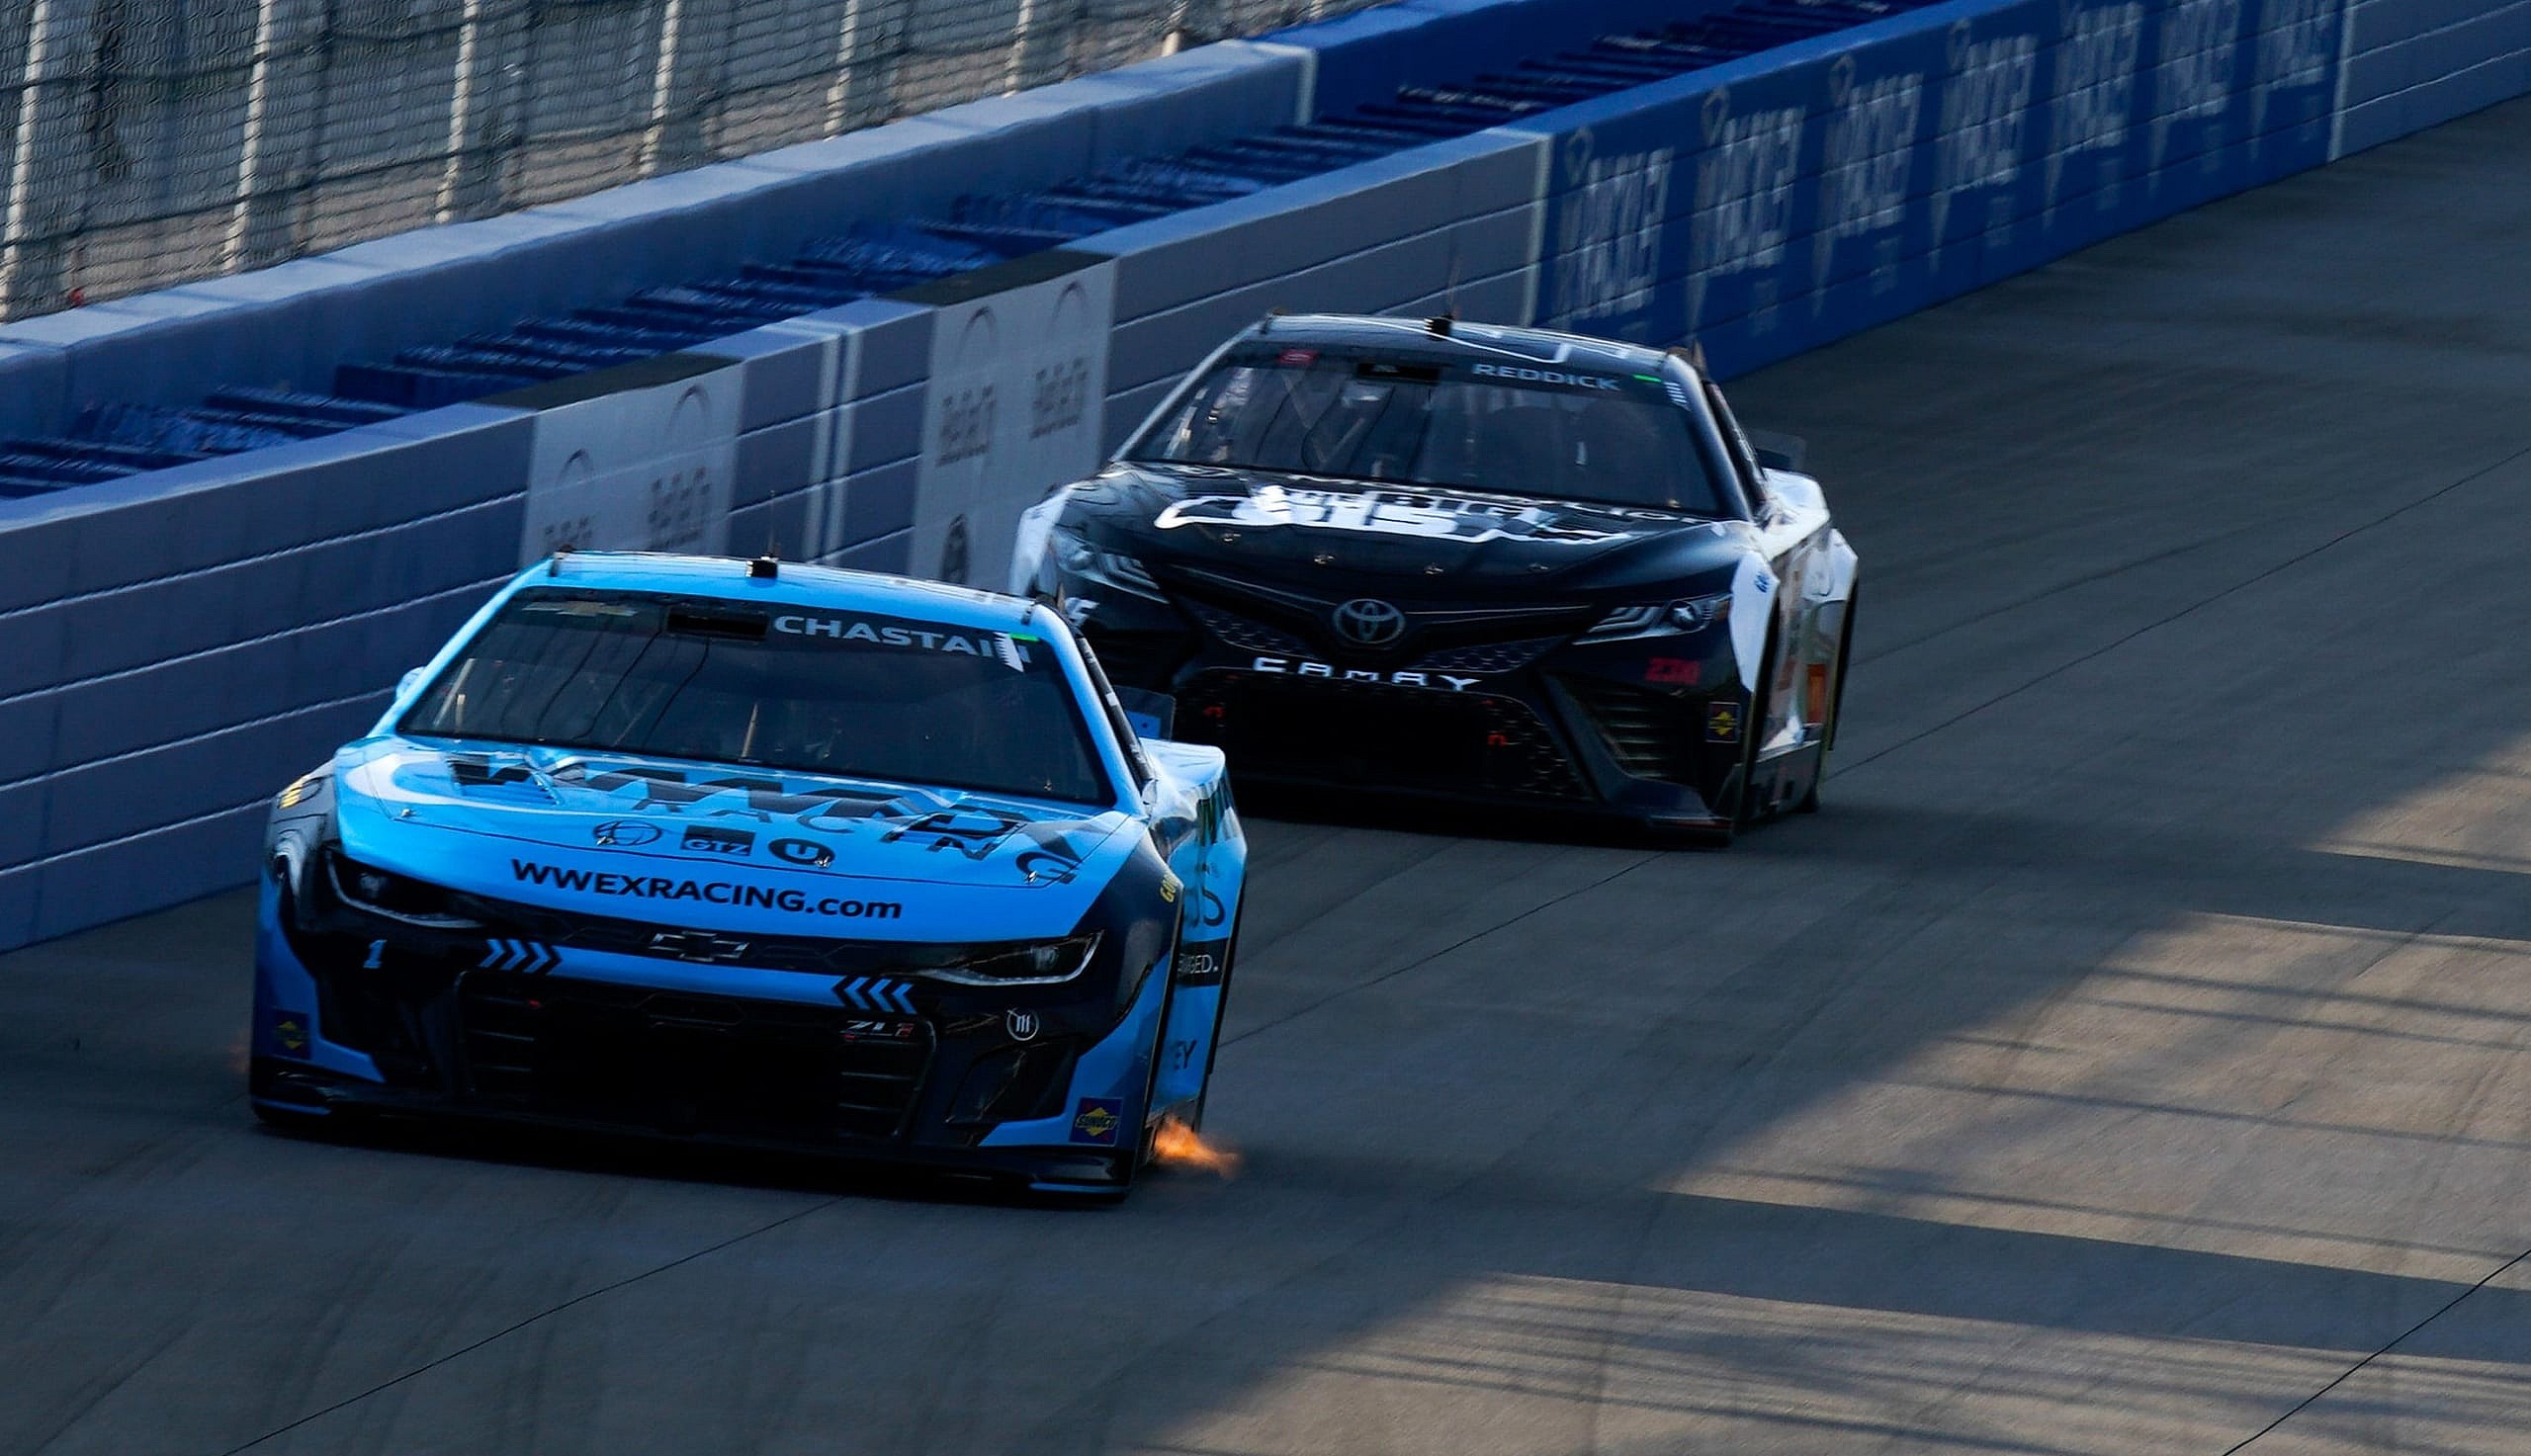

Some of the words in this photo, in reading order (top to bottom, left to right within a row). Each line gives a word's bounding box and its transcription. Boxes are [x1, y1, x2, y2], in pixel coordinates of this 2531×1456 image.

[1472, 363, 1621, 391] REDDICK
[1252, 656, 1484, 692] CAMRY
[510, 858, 903, 919] WWEXRACING.com
[363, 939, 389, 970] 1
